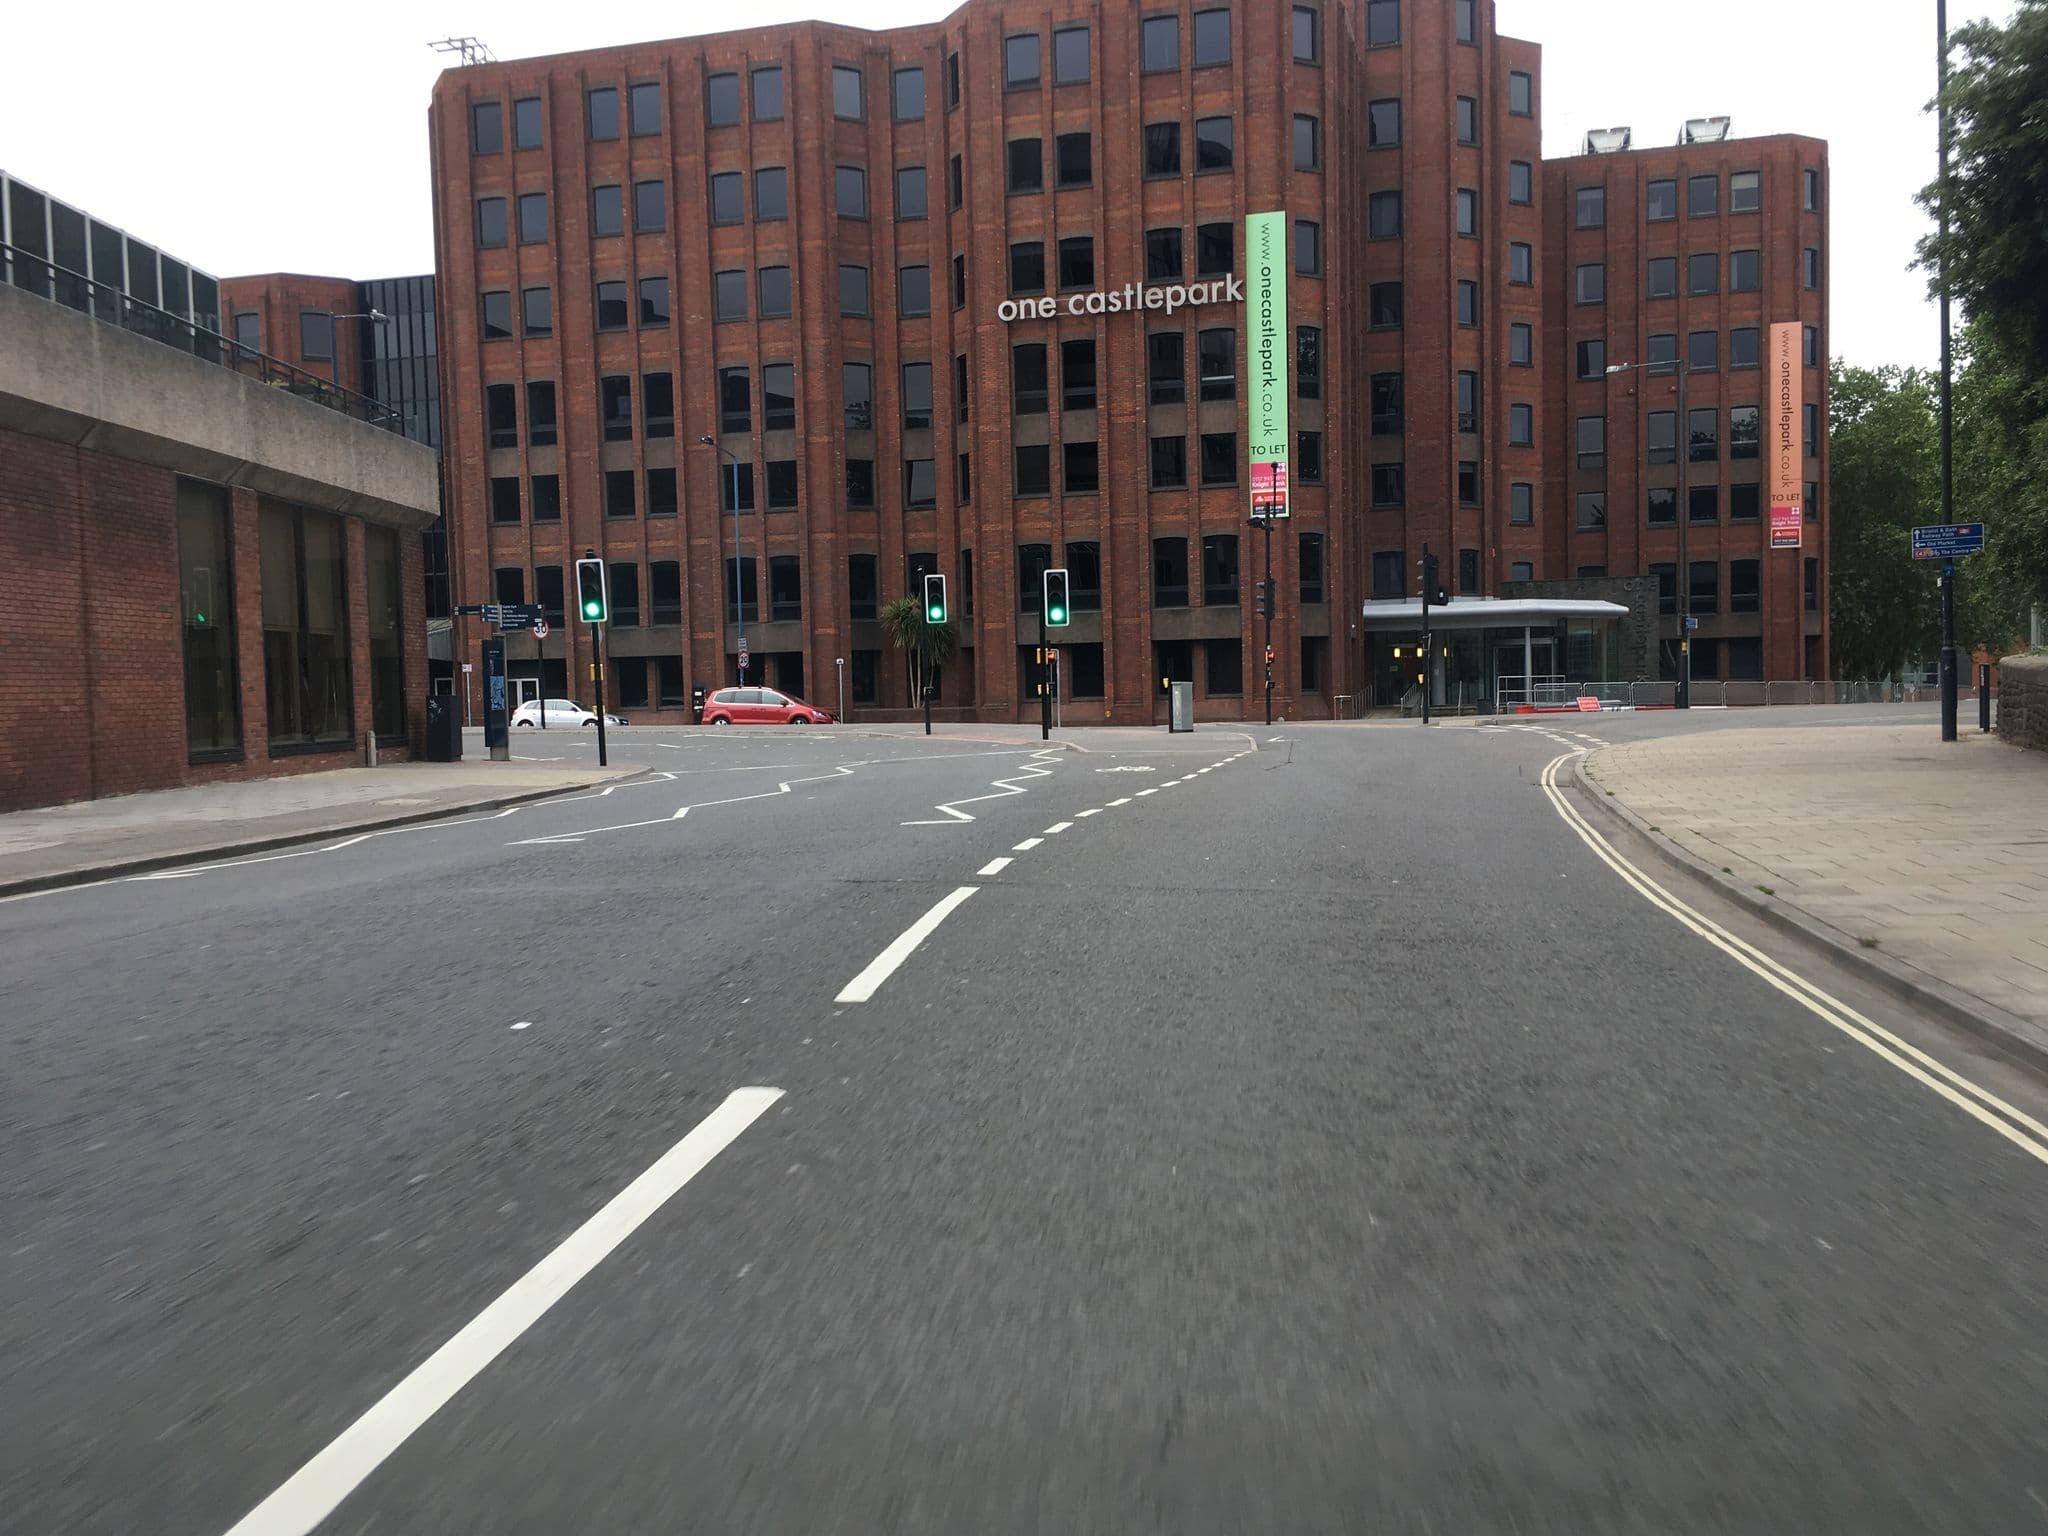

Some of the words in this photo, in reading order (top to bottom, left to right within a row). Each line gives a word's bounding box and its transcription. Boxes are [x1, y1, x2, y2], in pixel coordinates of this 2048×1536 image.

[997, 296, 1057, 322] one
[1068, 273, 1244, 315] castlepark
[1258, 222, 1278, 437] www.onecastlepark.co.uk
[1779, 329, 1794, 488] www.onecastlepark.co.uk
[1250, 445, 1266, 455] TO
[1269, 444, 1286, 454] LET
[1786, 493, 1800, 501] LET
[535, 625, 546, 633] 30
